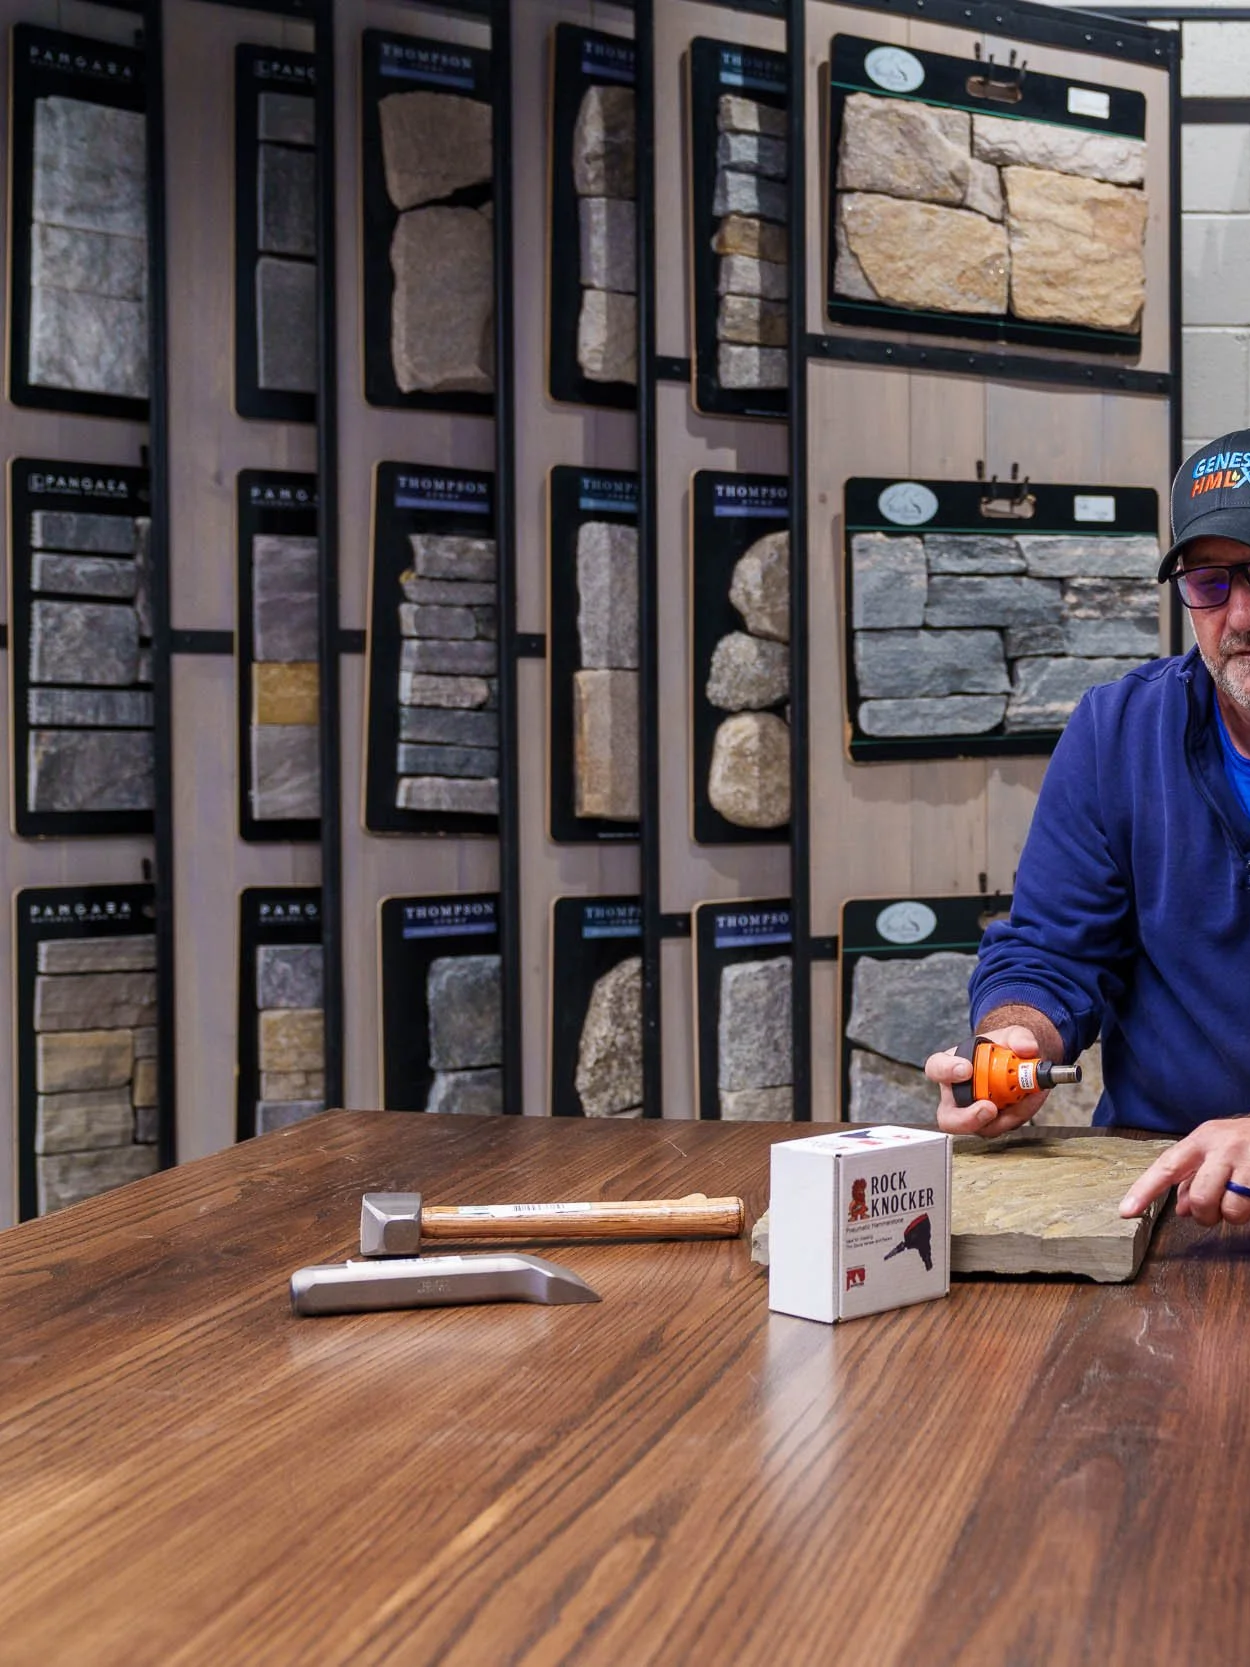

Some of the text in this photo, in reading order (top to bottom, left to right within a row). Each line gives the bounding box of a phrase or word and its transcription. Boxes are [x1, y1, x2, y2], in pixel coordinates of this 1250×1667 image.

[382, 42, 471, 69] THOMPSON
[271, 61, 316, 79] PANG
[398, 475, 488, 494] THOMPSON
[583, 479, 638, 493] THOMP
[715, 484, 788, 499] THOMPSO
[250, 486, 318, 501] PANG
[259, 903, 318, 916] PANG
[404, 902, 495, 919] THOMPSON
[584, 903, 641, 919] THOMP
[716, 911, 790, 928] THOMPSO
[871, 1170, 907, 1196] ROCK
[871, 1187, 934, 1218] KNOCKER
